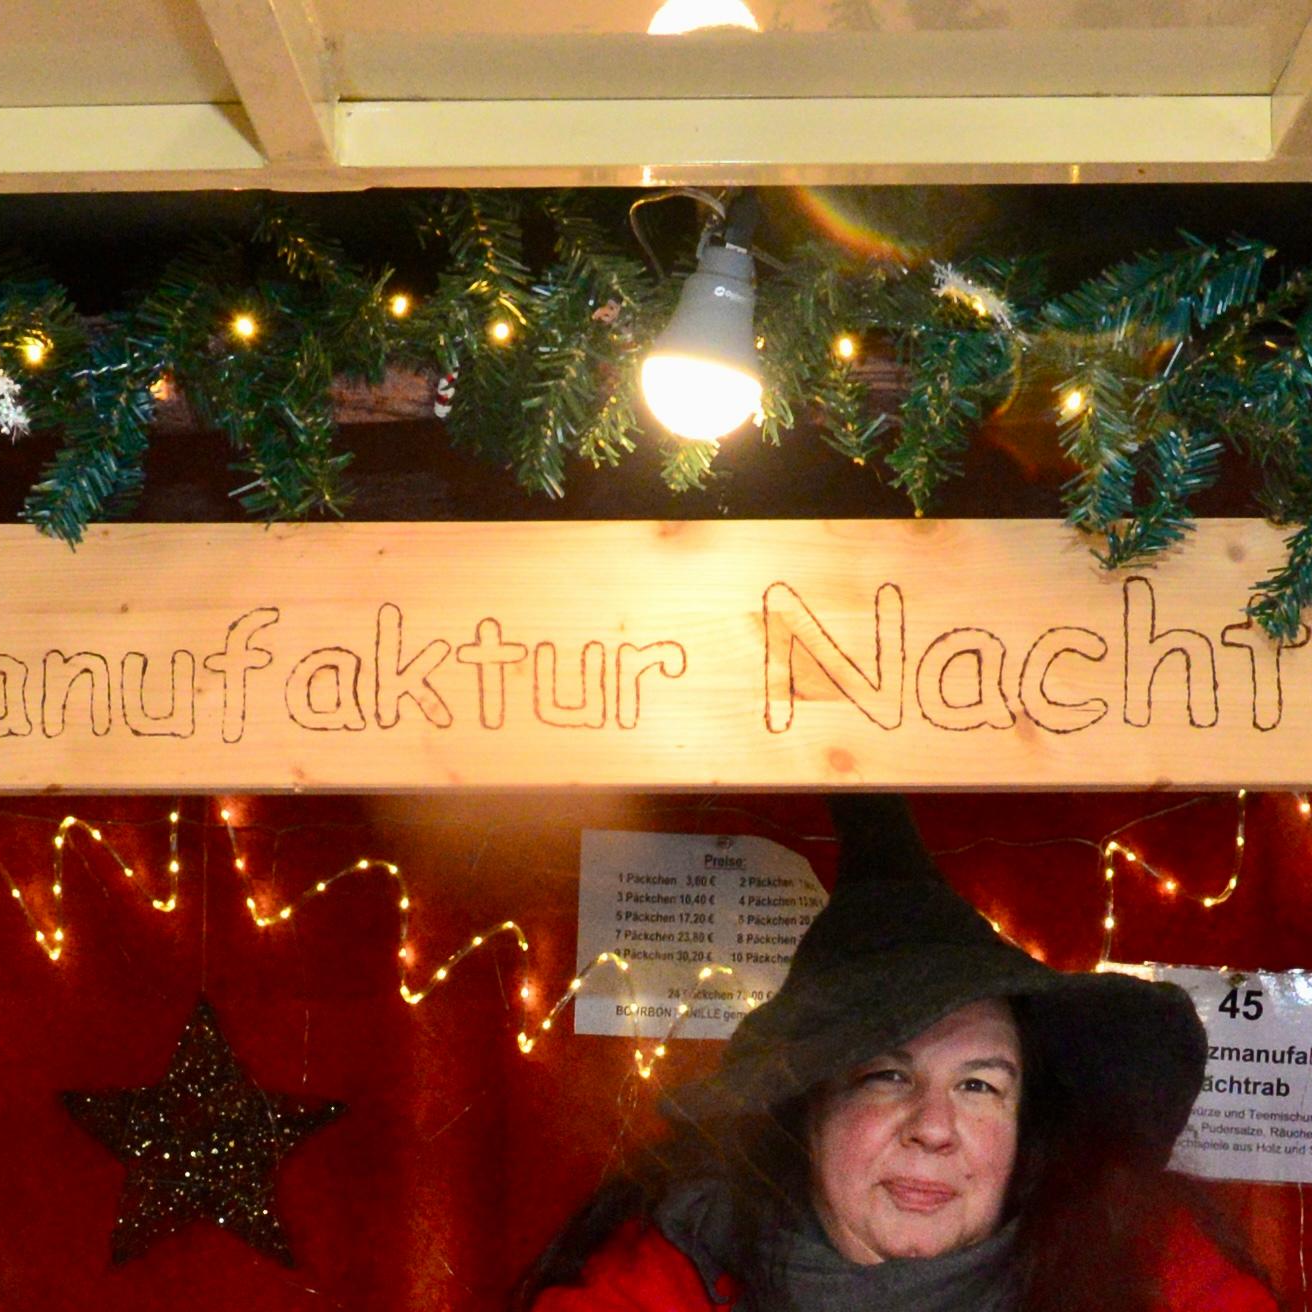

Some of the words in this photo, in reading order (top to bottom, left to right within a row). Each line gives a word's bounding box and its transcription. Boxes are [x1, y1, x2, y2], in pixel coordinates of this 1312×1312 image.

[618, 872, 624, 883] 1
[739, 877, 747, 888] 2
[616, 891, 624, 902] 3
[737, 895, 745, 906] 4
[614, 928, 622, 940] 7
[1218, 989, 1264, 1021] 45
[1224, 1108, 1246, 1120] und
[1284, 1144, 1307, 1156] und
